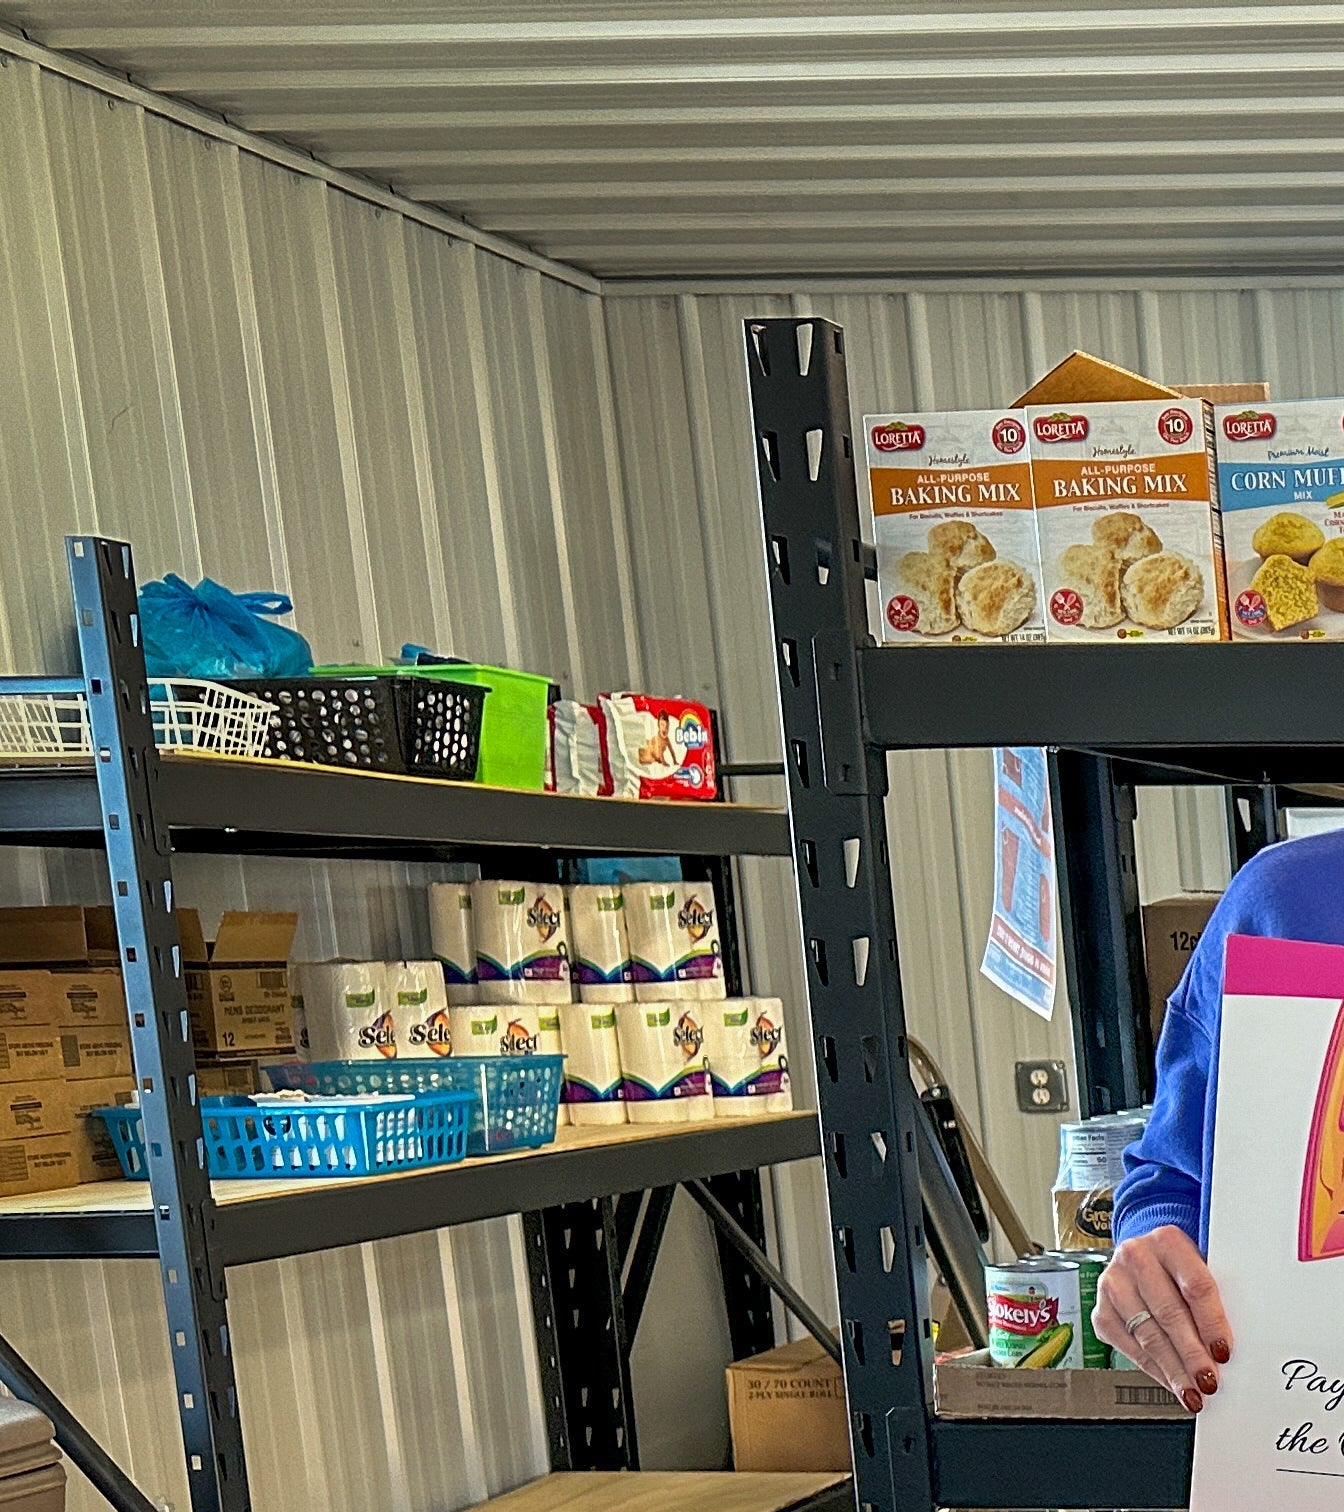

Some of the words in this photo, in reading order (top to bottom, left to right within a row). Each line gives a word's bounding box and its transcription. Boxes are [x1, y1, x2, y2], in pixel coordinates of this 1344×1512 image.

[1036, 421, 1085, 437] LORETTA
[1165, 418, 1184, 433] 10
[1226, 420, 1272, 436] LORETTA
[874, 430, 922, 445] LORETTA
[1000, 428, 1017, 442] 10
[1081, 463, 1156, 476] ALL-PURPOSE
[917, 472, 990, 484] ALL-PURPOSE
[1231, 470, 1287, 491] CORN
[1053, 476, 1137, 498] BAKING
[1144, 474, 1188, 493] MIX
[890, 485, 971, 506] BAKING
[978, 483, 1021, 501] MIX
[1293, 490, 1313, 500] MIX
[1275, 1422, 1329, 1455] the
